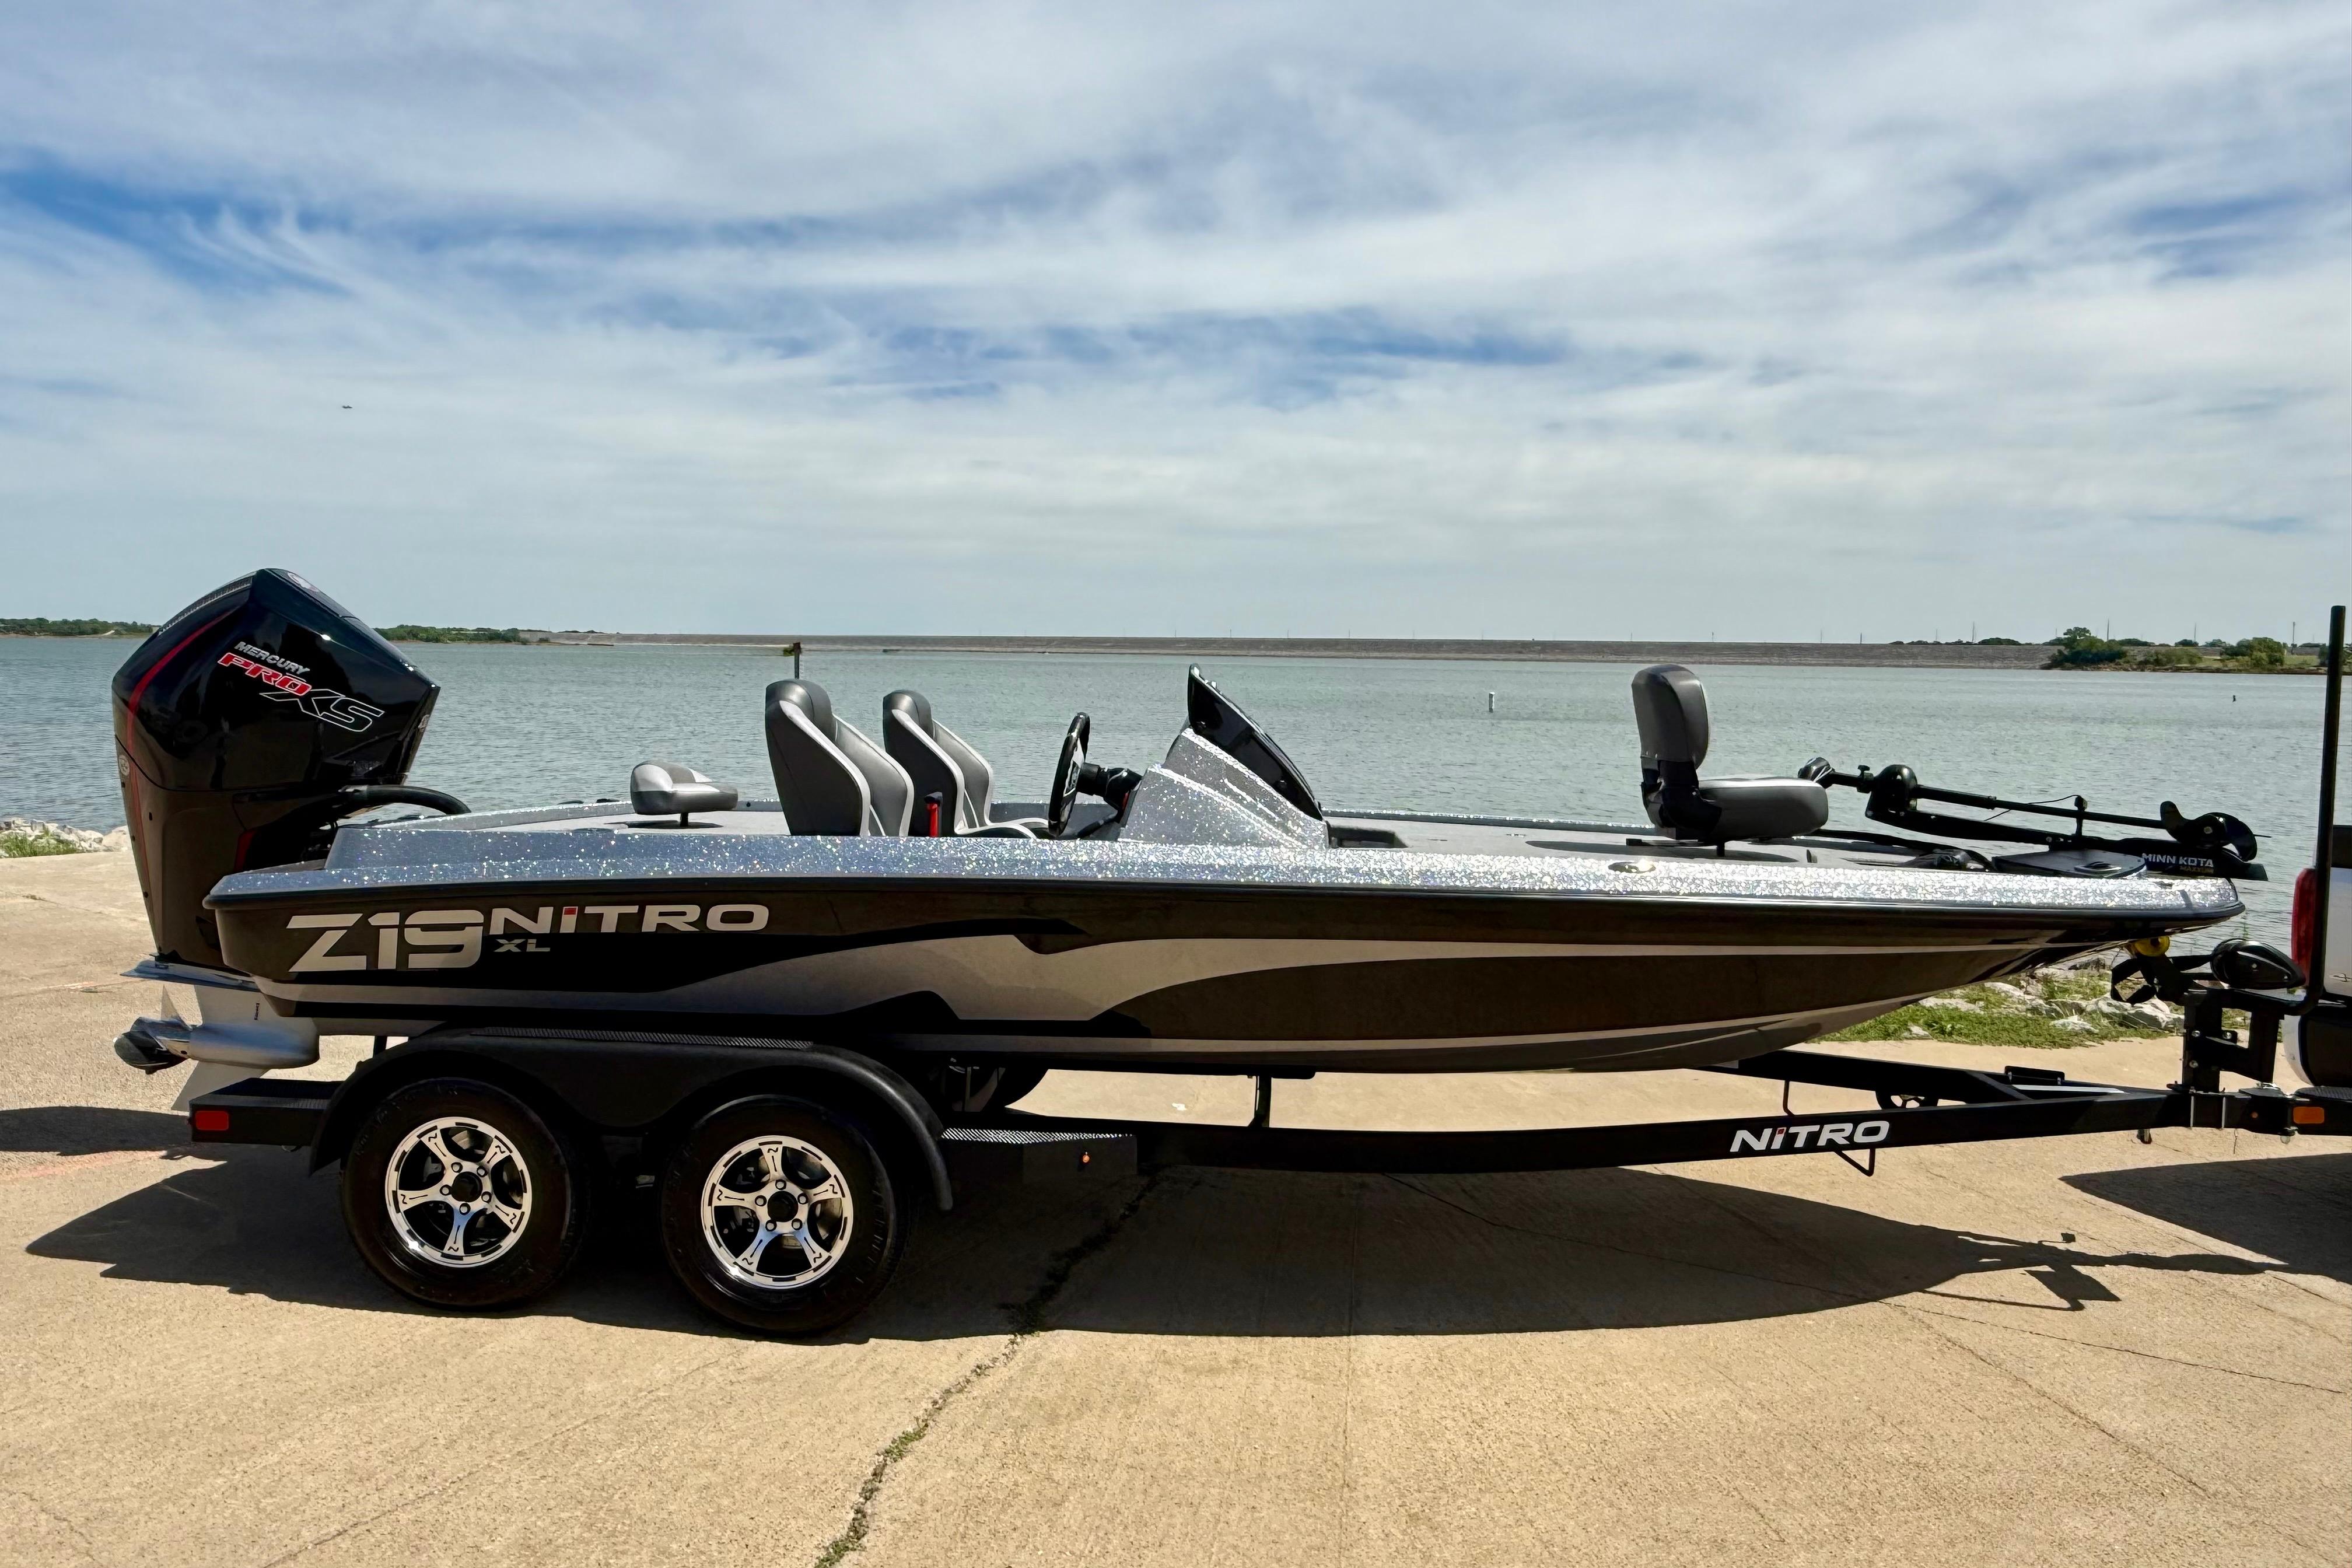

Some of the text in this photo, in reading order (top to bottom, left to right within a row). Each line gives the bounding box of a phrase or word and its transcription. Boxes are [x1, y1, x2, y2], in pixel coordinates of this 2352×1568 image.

[235, 642, 310, 674] MERCURY
[218, 652, 385, 732] PRO XS
[2141, 853, 2214, 867] MINN KOTA
[286, 909, 484, 972] Z19
[494, 939, 551, 953] XL
